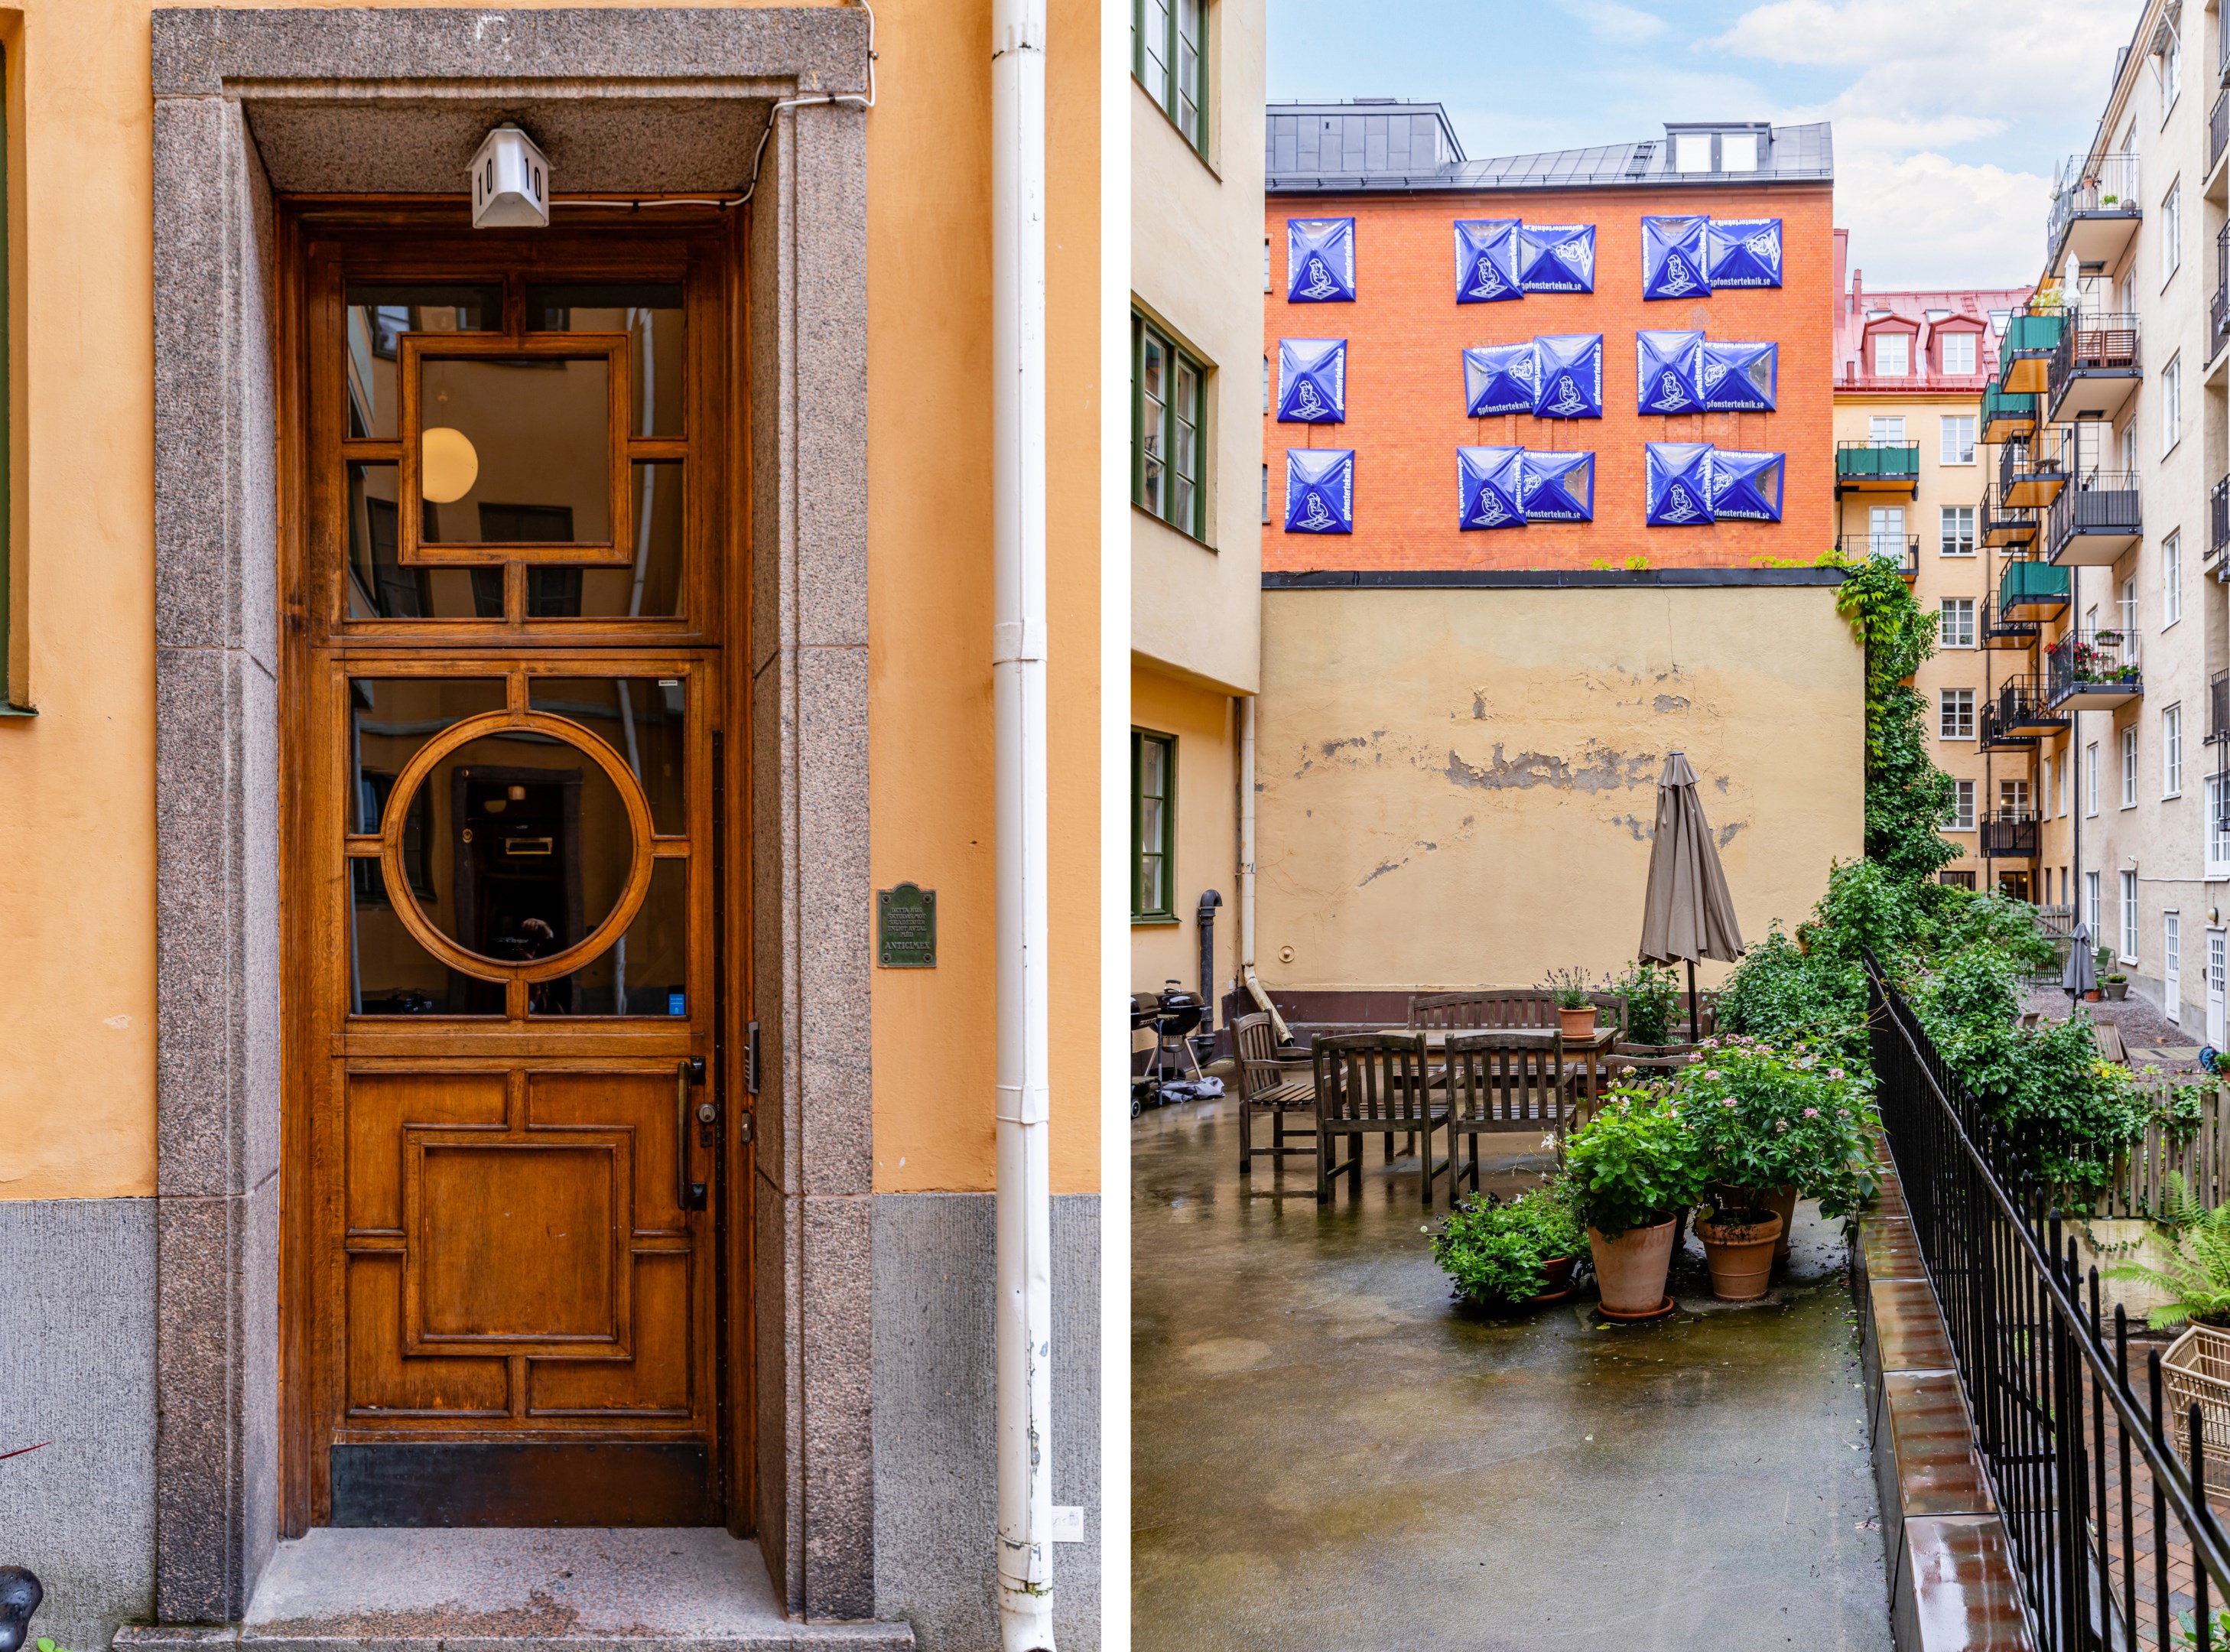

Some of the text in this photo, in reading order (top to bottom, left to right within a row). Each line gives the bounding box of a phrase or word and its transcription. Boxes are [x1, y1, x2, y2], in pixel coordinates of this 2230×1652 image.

[478, 158, 492, 206] 10
[525, 158, 541, 202] 10
[1344, 226, 1354, 288] gpfonsterteknik.se
[1334, 348, 1344, 410] gpfonsterteknik.se
[1593, 343, 1601, 405] gpfonsterteknik.se
[1706, 400, 1764, 409] pfonsterteknik.se
[1342, 459, 1352, 521] gpfonsterteknik.se
